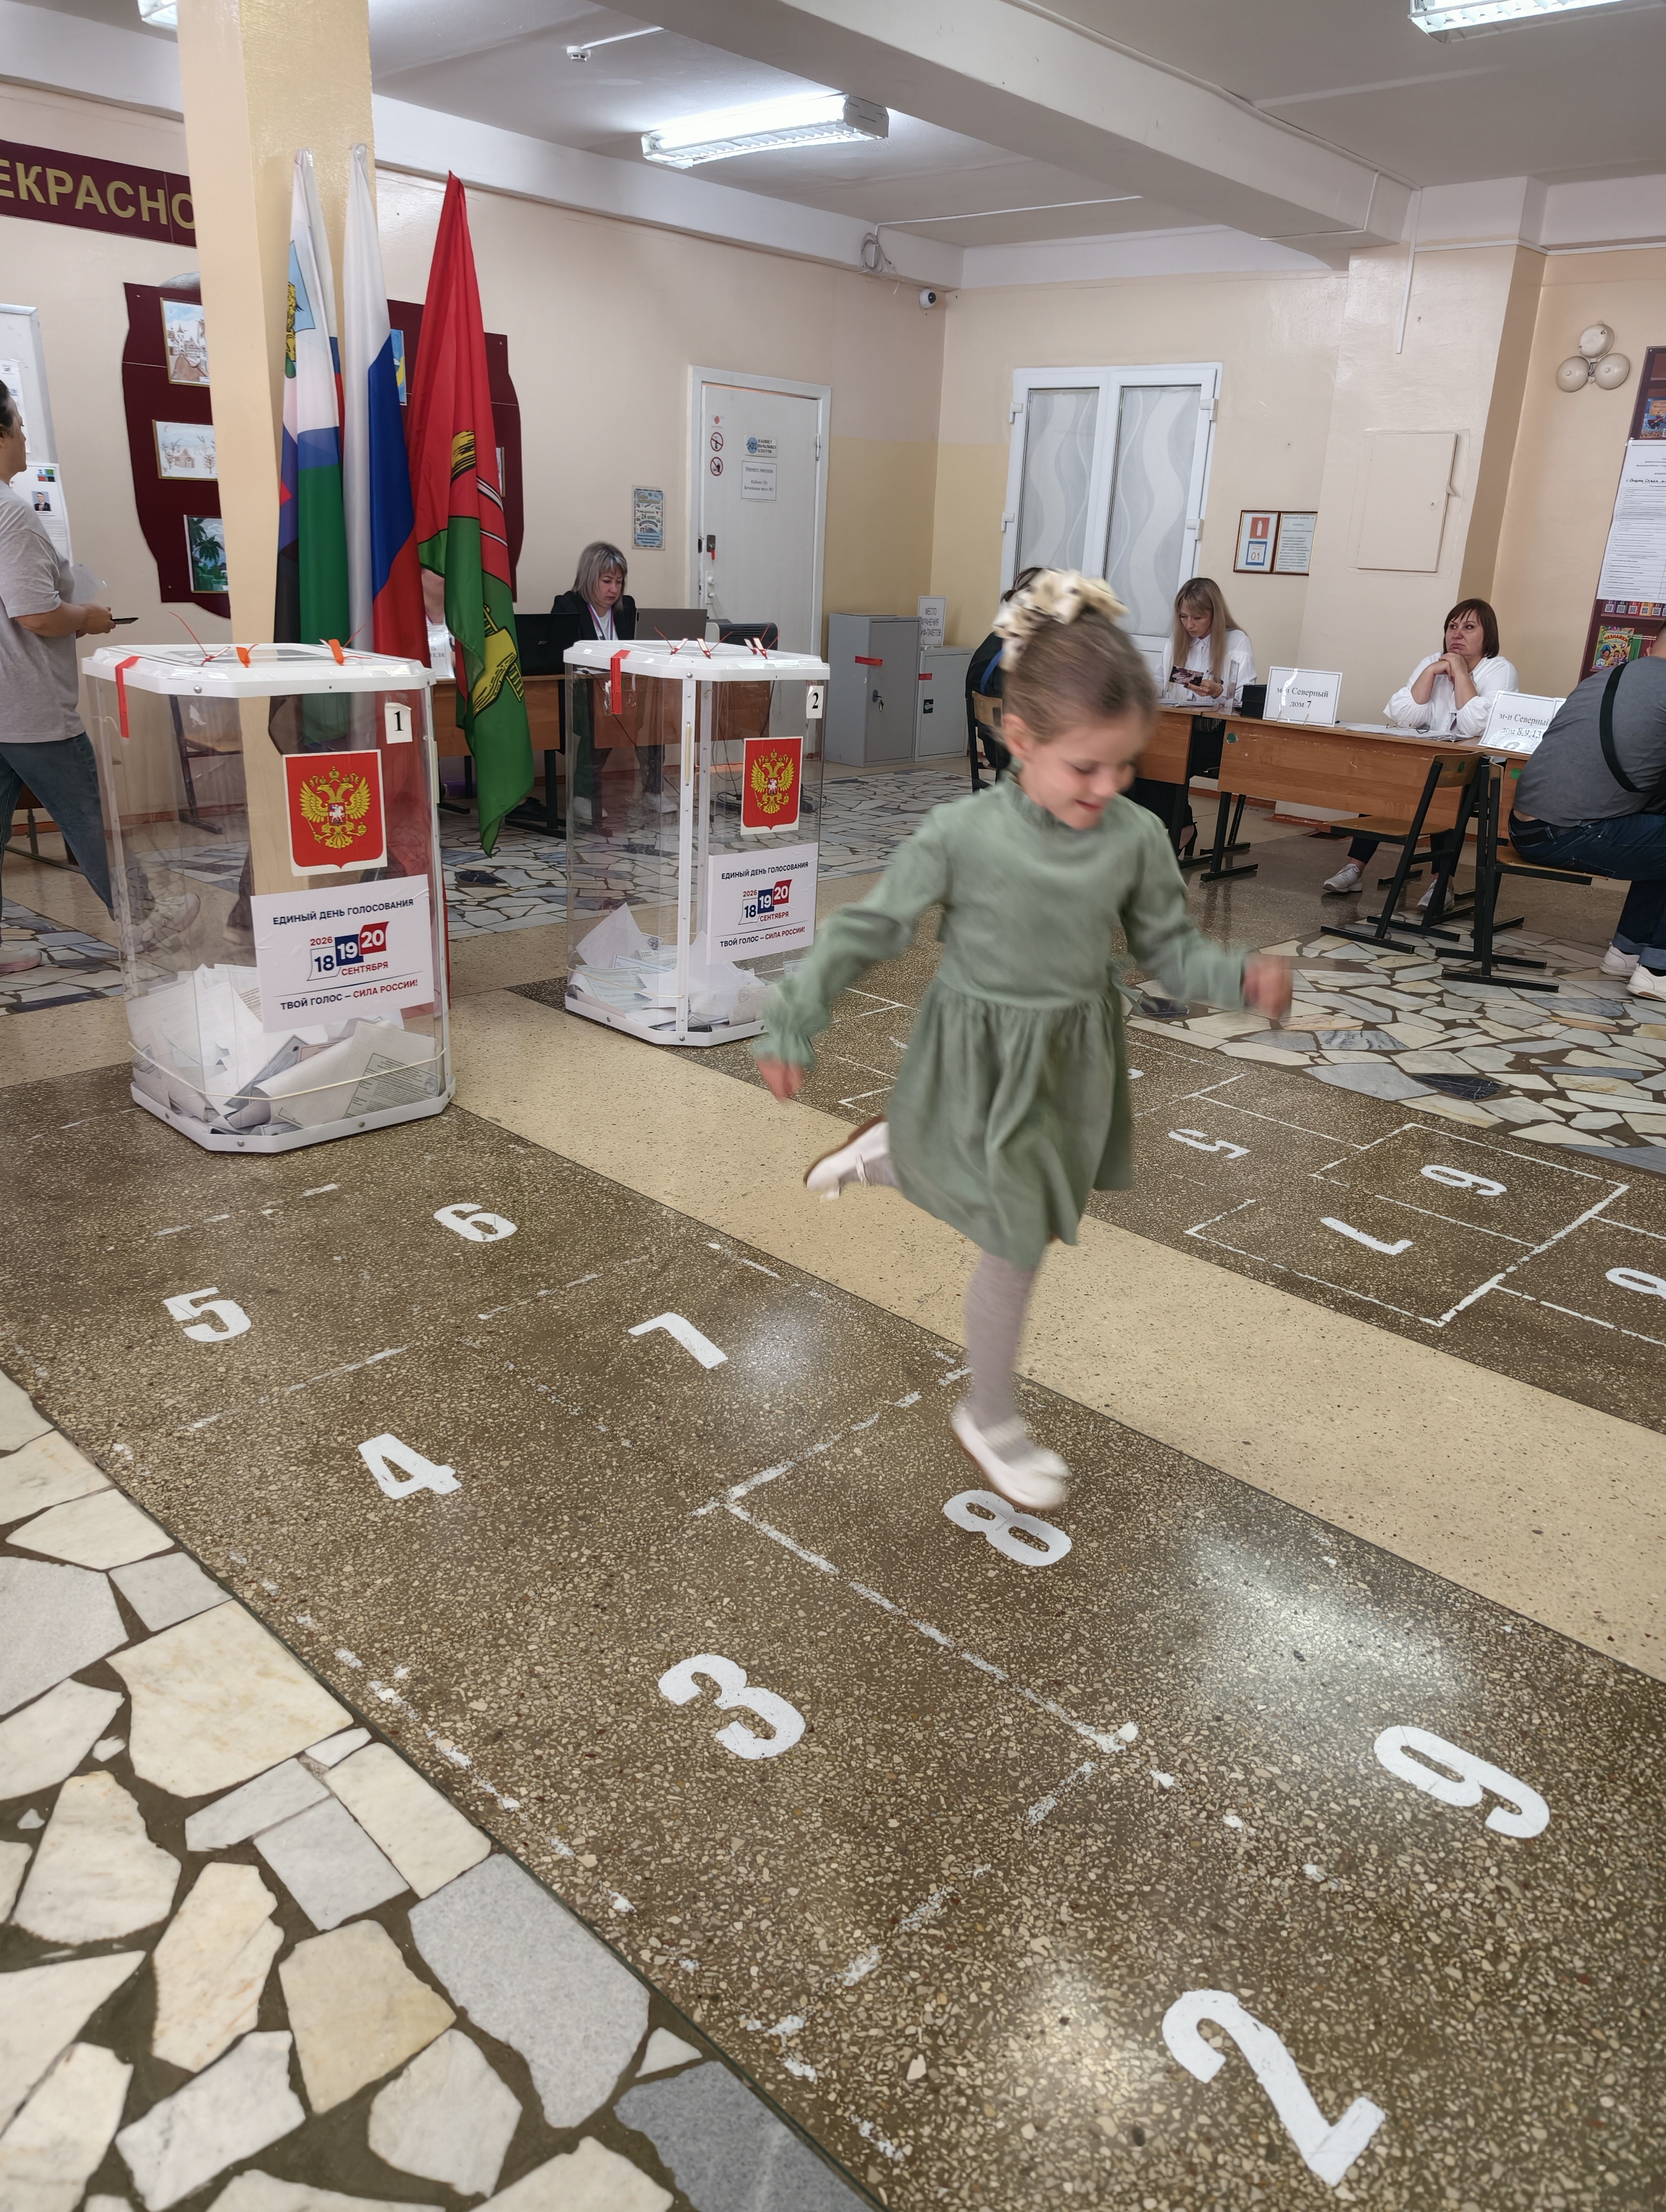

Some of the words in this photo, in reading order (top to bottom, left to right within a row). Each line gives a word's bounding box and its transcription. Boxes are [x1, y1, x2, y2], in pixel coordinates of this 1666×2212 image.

[1251, 552, 1260, 561] 01
[812, 692, 818, 709] 2
[1292, 687, 1328, 698] Северный
[394, 711, 405, 731] 1
[722, 870, 749, 880] ЕДИНЫЙ
[751, 868, 767, 877] ДЕНЬ
[768, 861, 809, 873] ГОЛОСОВАНИЯ
[273, 911, 316, 925] ЕДИНЫЙ
[319, 909, 345, 921] ДЕНЬ
[348, 899, 414, 916] ГОЛОСОВАНИЯ
[744, 904, 756, 918] 18
[759, 895, 771, 909] 19
[774, 885, 789, 900] 20
[760, 911, 789, 922] СЕНТЯБРЯ
[310, 936, 333, 946] 2026
[315, 955, 335, 972] 18
[337, 942, 357, 960] 19
[361, 929, 384, 948] 20
[720, 938, 738, 947] ТВОЙ
[739, 936, 759, 944] ГОЛОС
[765, 931, 781, 940] СИЛА
[782, 926, 805, 936] РОССИИ!
[342, 961, 388, 976] СЕНТЯБРЯ
[280, 996, 308, 1010] ТВОЙ
[311, 994, 343, 1006] ГОЛОС
[353, 988, 378, 999] СИЛА
[381, 979, 418, 993] РОССИИ!
[433, 1203, 517, 1242] 6
[163, 1286, 252, 1342] 5
[627, 1311, 729, 1369] 7
[357, 1432, 462, 1500] 4
[943, 1489, 1072, 1567] 8
[658, 1653, 806, 1760] 3
[1373, 1724, 1550, 1838] 9
[1161, 1989, 1386, 2187] 2
